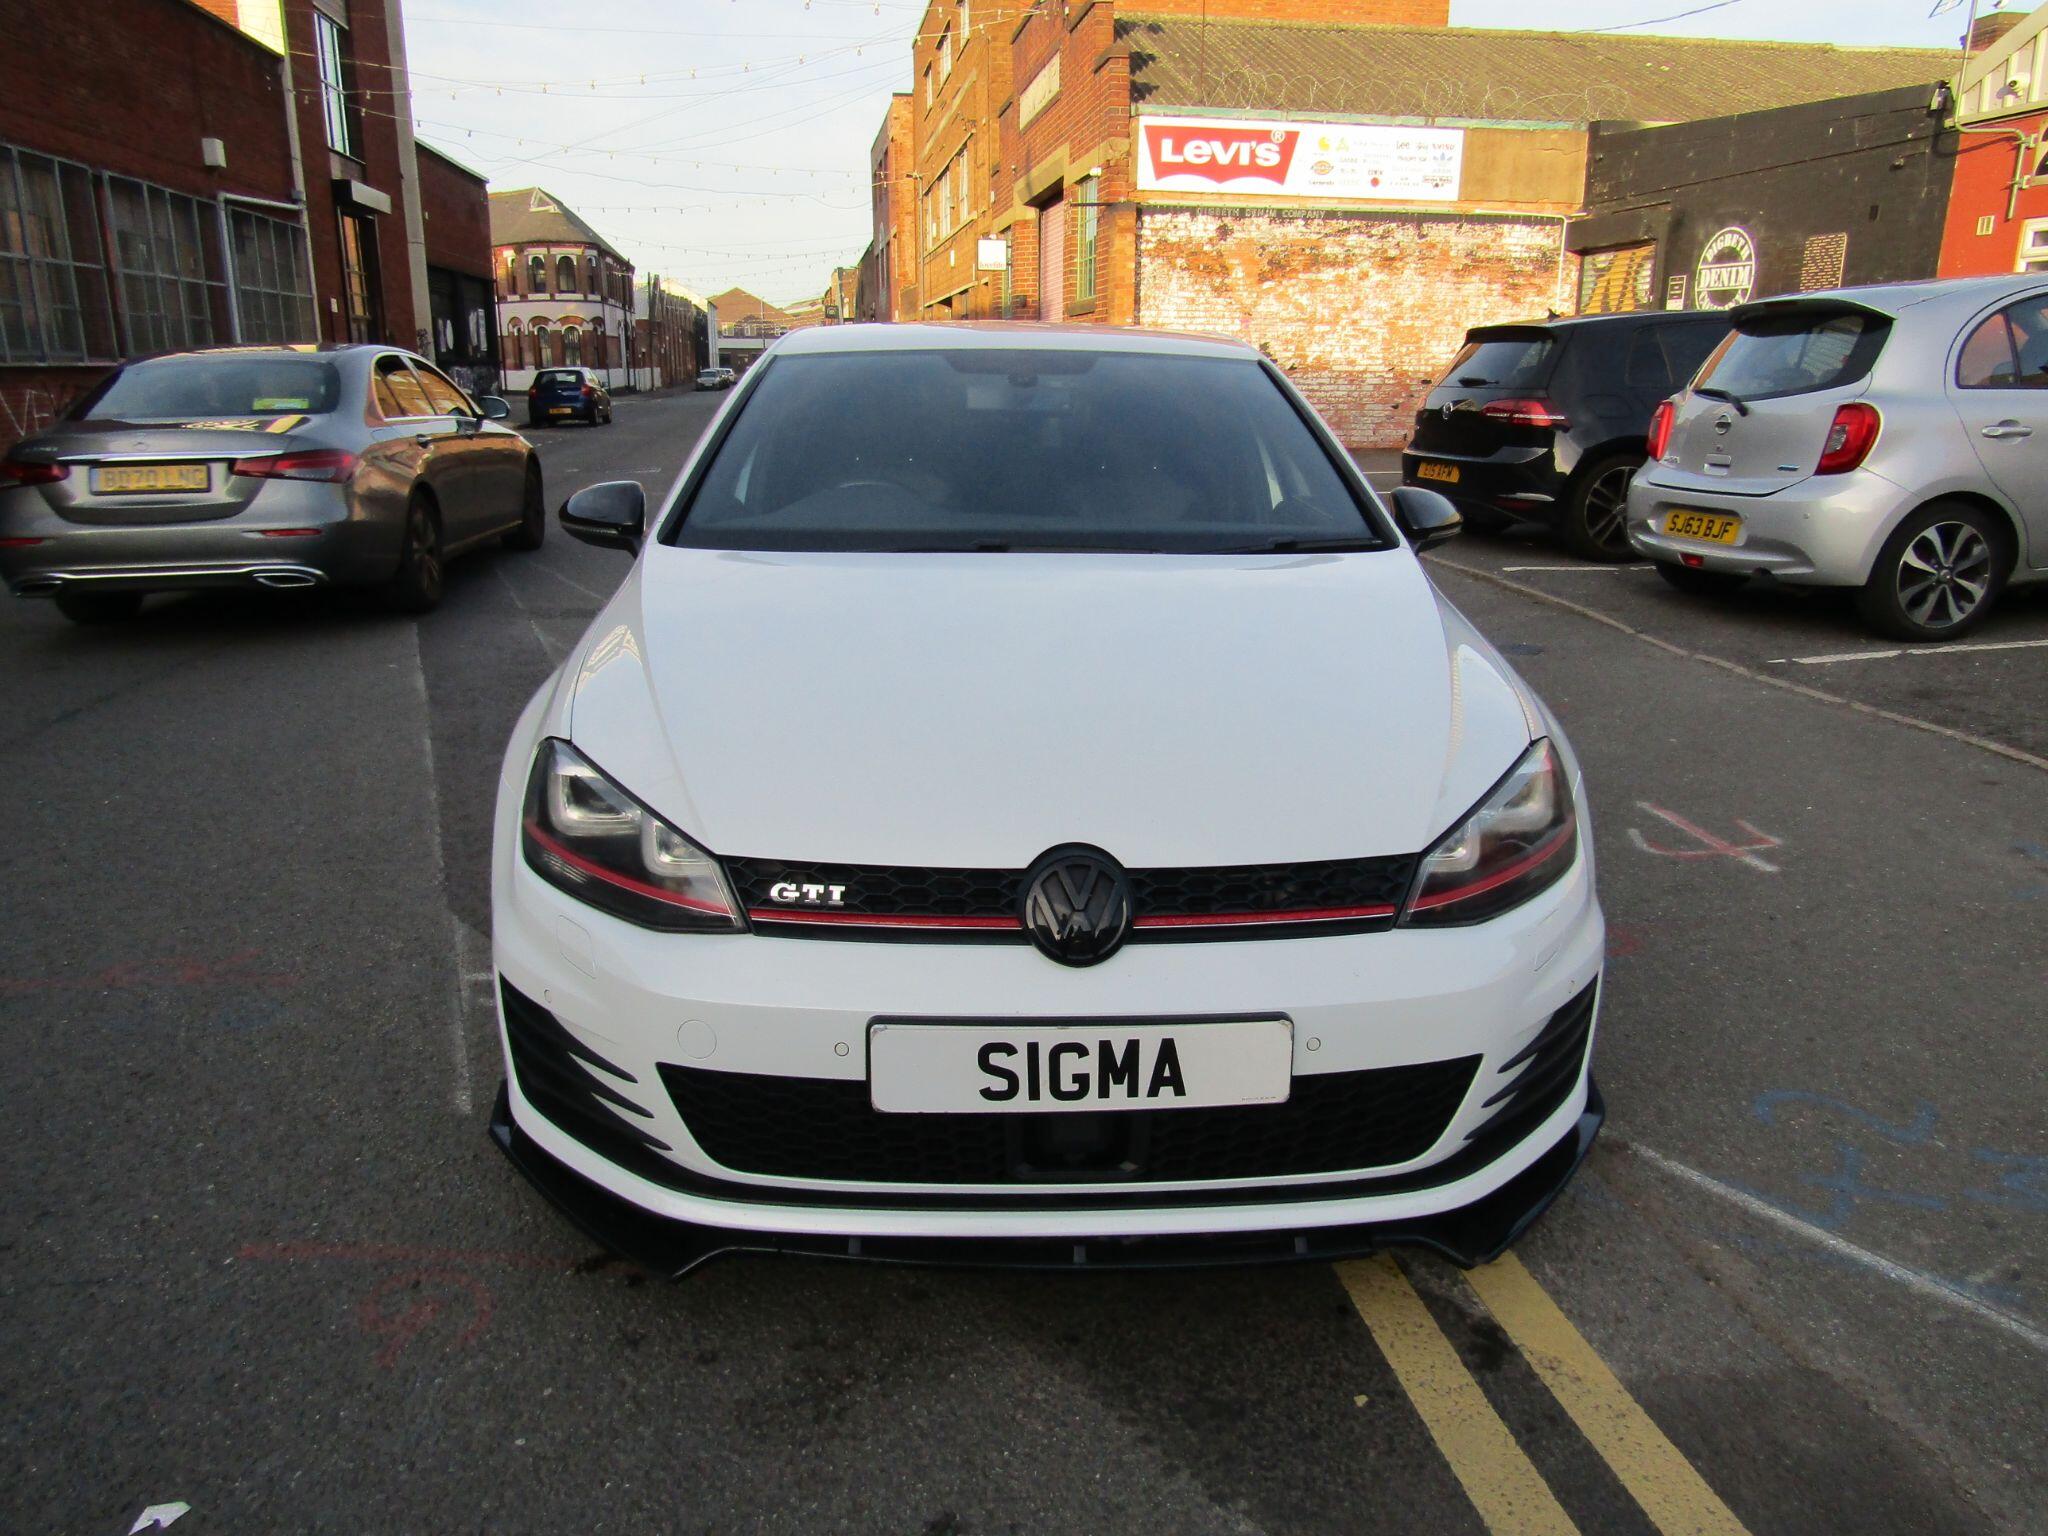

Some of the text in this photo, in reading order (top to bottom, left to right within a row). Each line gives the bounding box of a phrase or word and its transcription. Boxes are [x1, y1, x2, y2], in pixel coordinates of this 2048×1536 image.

[1705, 233, 1751, 263] DIGBETH
[1700, 265, 1751, 288] DENIM
[1669, 514, 1734, 540] SJ63 BJF
[770, 882, 846, 906] GTI
[977, 1038, 1187, 1102] SIGMA
